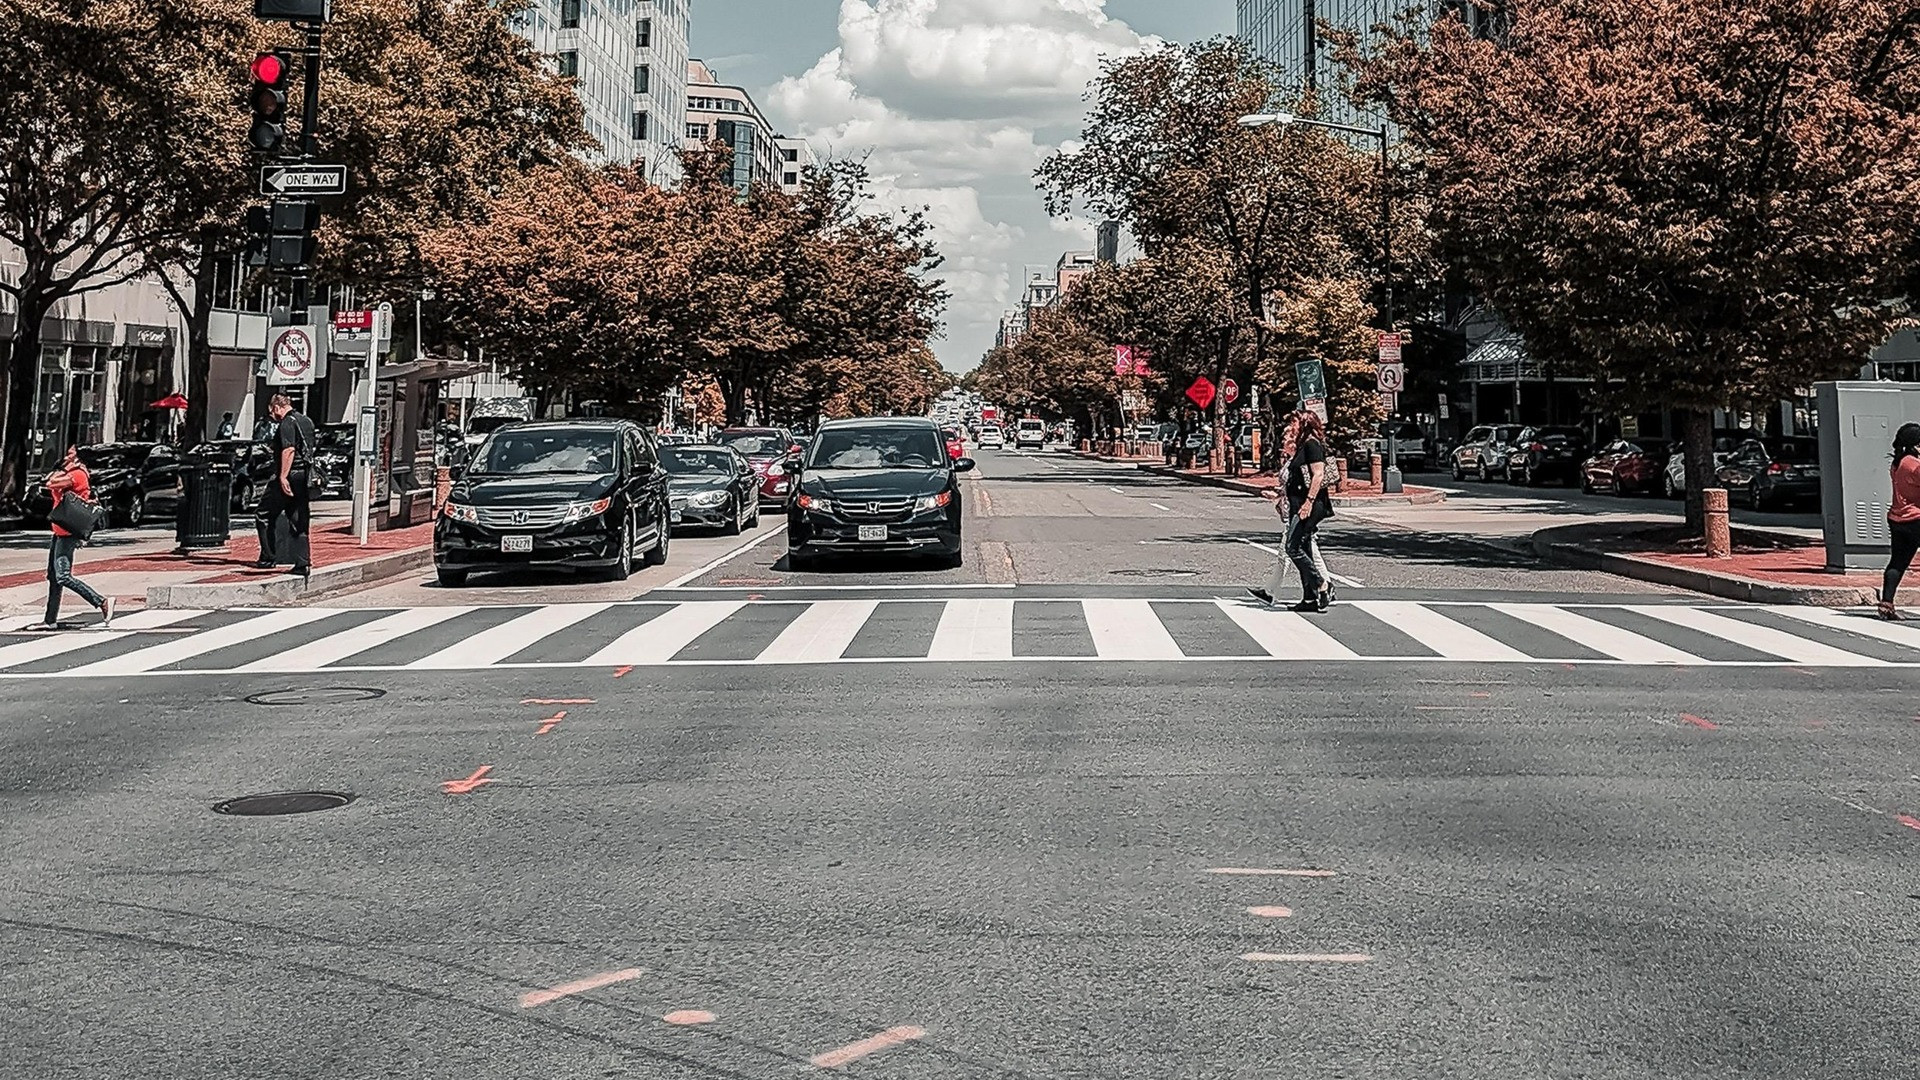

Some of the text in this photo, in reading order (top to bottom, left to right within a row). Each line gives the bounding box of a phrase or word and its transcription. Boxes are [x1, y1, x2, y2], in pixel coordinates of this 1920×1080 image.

[286, 174, 337, 185] ONE WAY
[285, 335, 302, 345] Red
[280, 346, 305, 358] Light
[1117, 349, 1131, 365] K
[271, 359, 311, 370] Running
